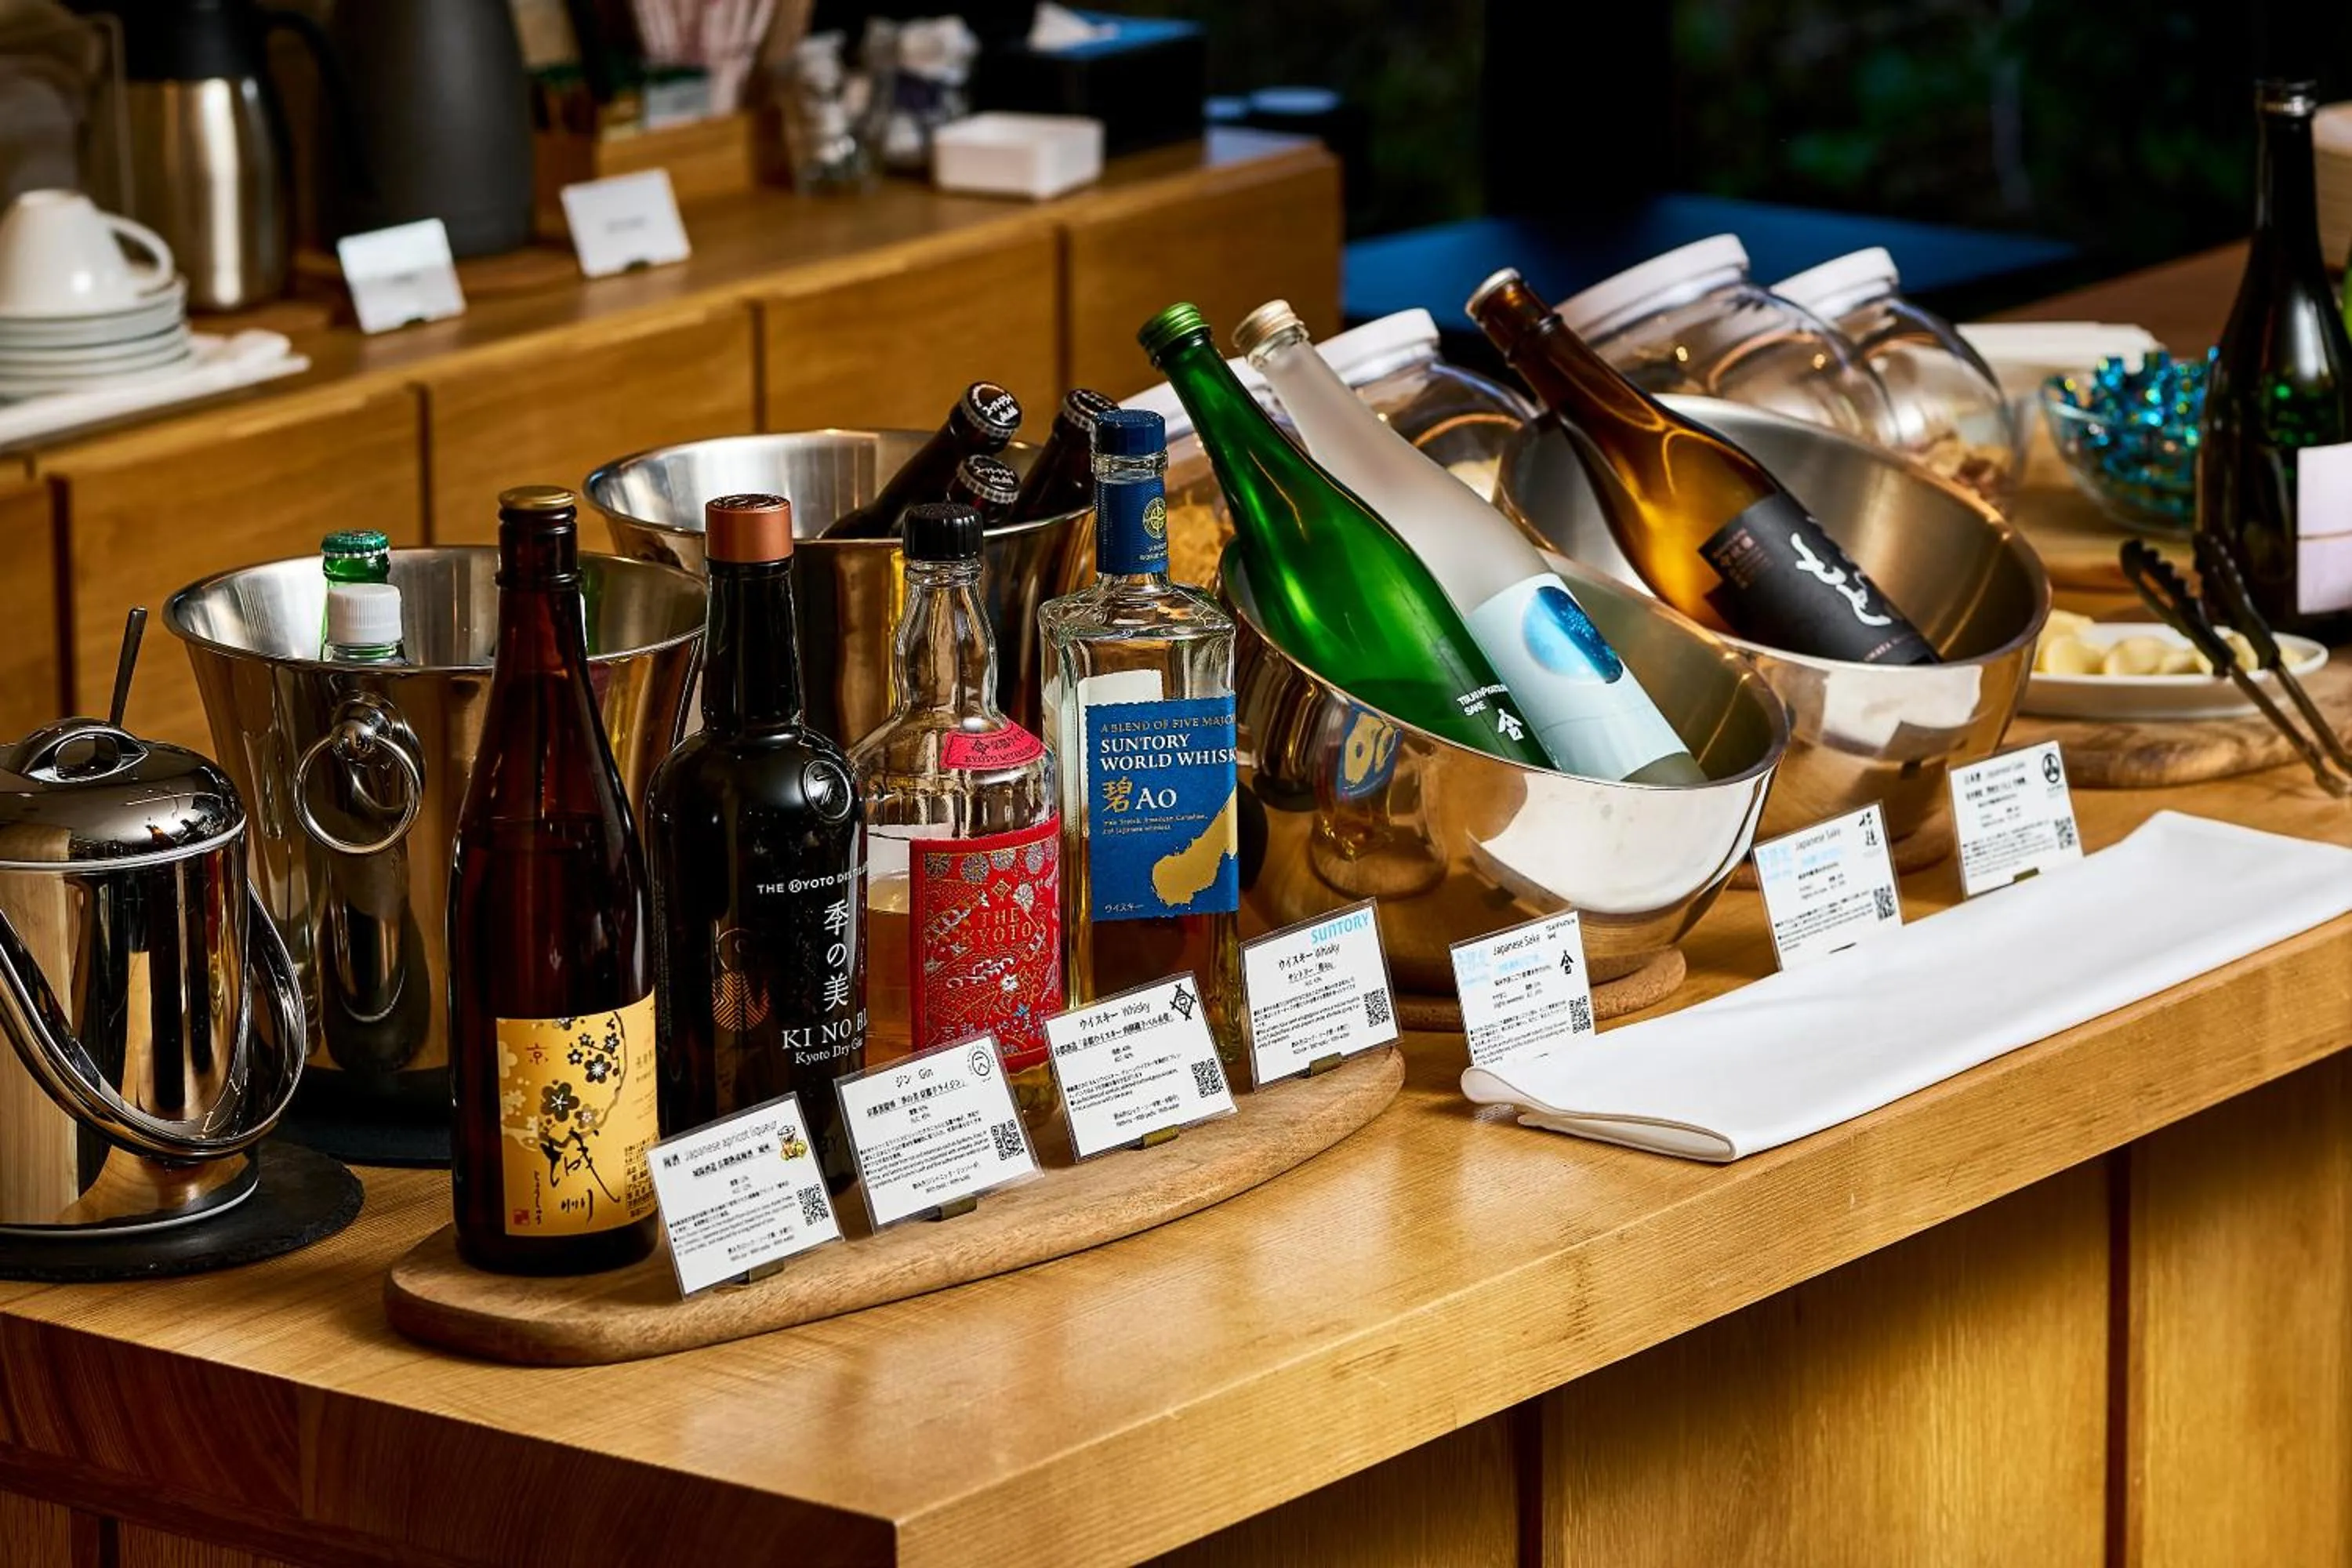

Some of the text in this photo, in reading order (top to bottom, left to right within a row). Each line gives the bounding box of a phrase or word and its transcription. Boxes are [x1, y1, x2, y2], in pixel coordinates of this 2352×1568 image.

[1101, 724, 1109, 733] A
[1111, 721, 1150, 732] BLEND
[1153, 720, 1169, 730] OF
[1173, 717, 1199, 728] FIVE
[1100, 733, 1190, 753] SUNTORY
[1100, 756, 1172, 771] WORLD
[757, 882, 785, 895] THE
[788, 876, 835, 893] KYOTO
[978, 907, 1020, 928] THE
[1310, 910, 1370, 945] SUNTORY
[823, 898, 851, 1012] 季の美
[1278, 952, 1314, 972] ウイスキー
[1079, 1000, 1151, 1032] ウイスキー Whisky
[782, 1027, 813, 1050] KI
[821, 1018, 852, 1044] NO
[794, 1051, 830, 1065] Kyoto
[832, 1044, 851, 1058] Dry
